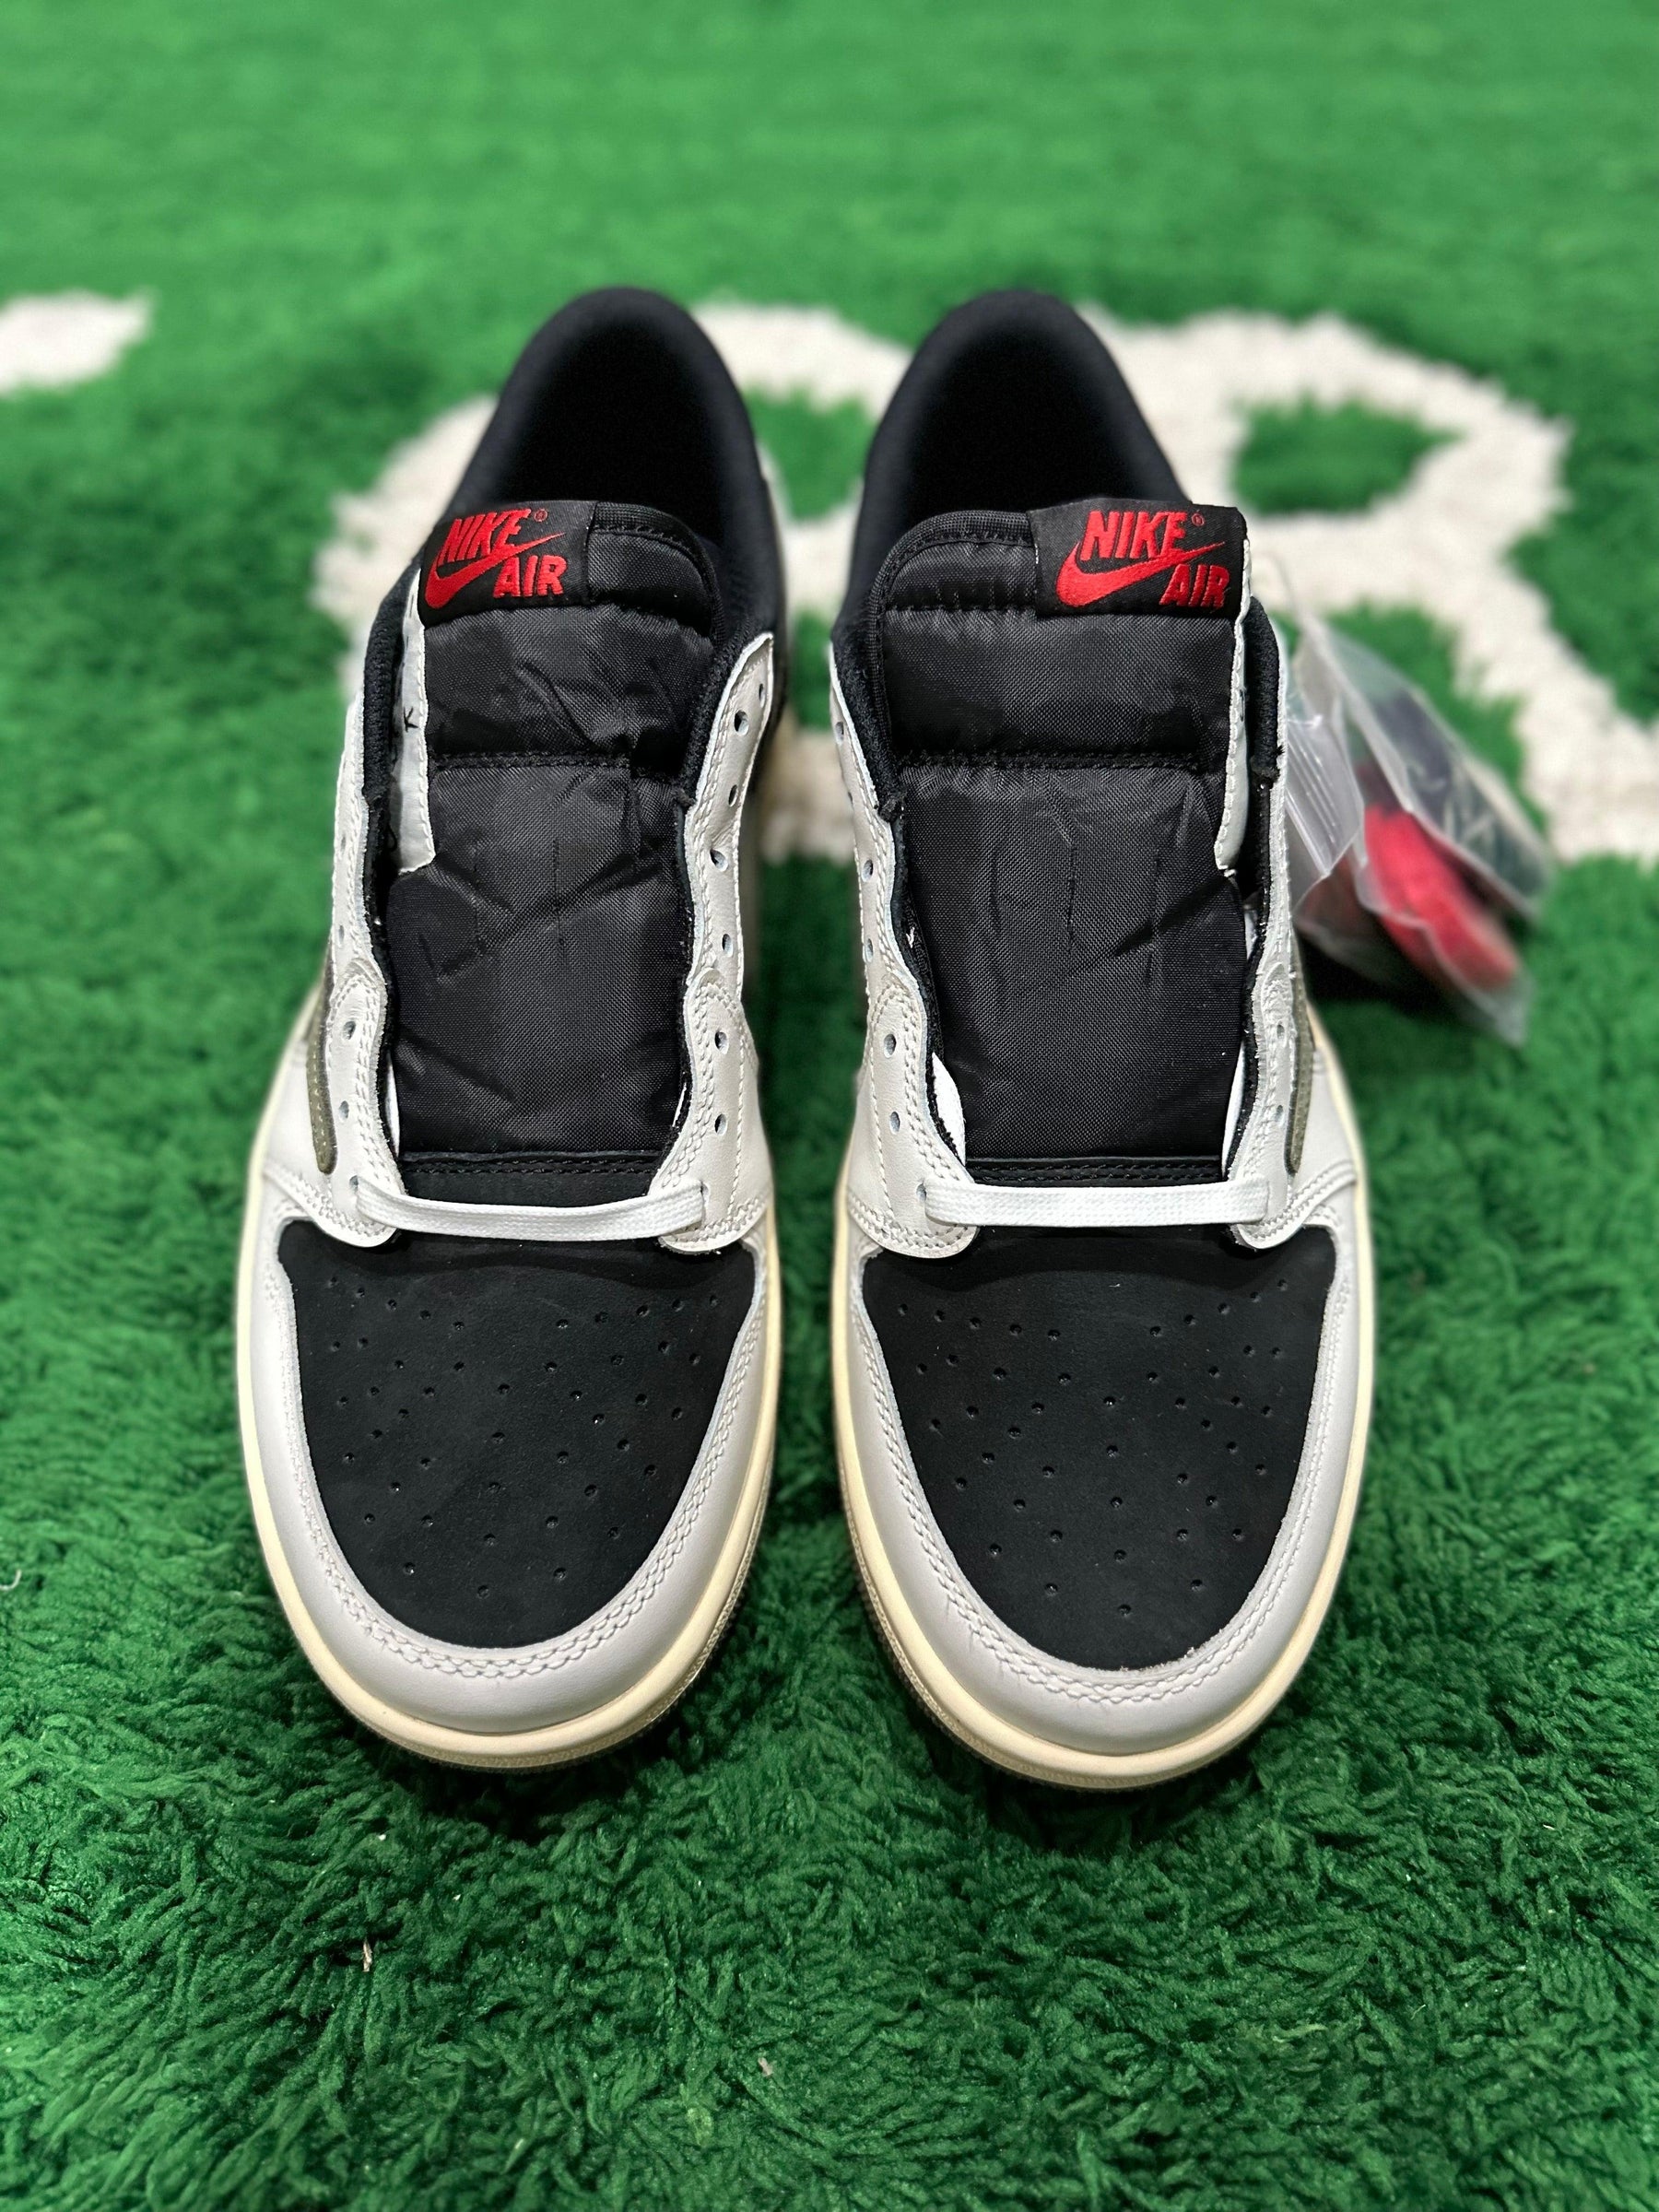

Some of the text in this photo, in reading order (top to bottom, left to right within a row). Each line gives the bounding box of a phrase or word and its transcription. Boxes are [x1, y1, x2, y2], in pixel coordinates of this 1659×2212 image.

[437, 508, 532, 566] NIKE
[1079, 510, 1188, 561] NIKE
[492, 555, 568, 599] AIR
[1159, 563, 1230, 608] AIR
